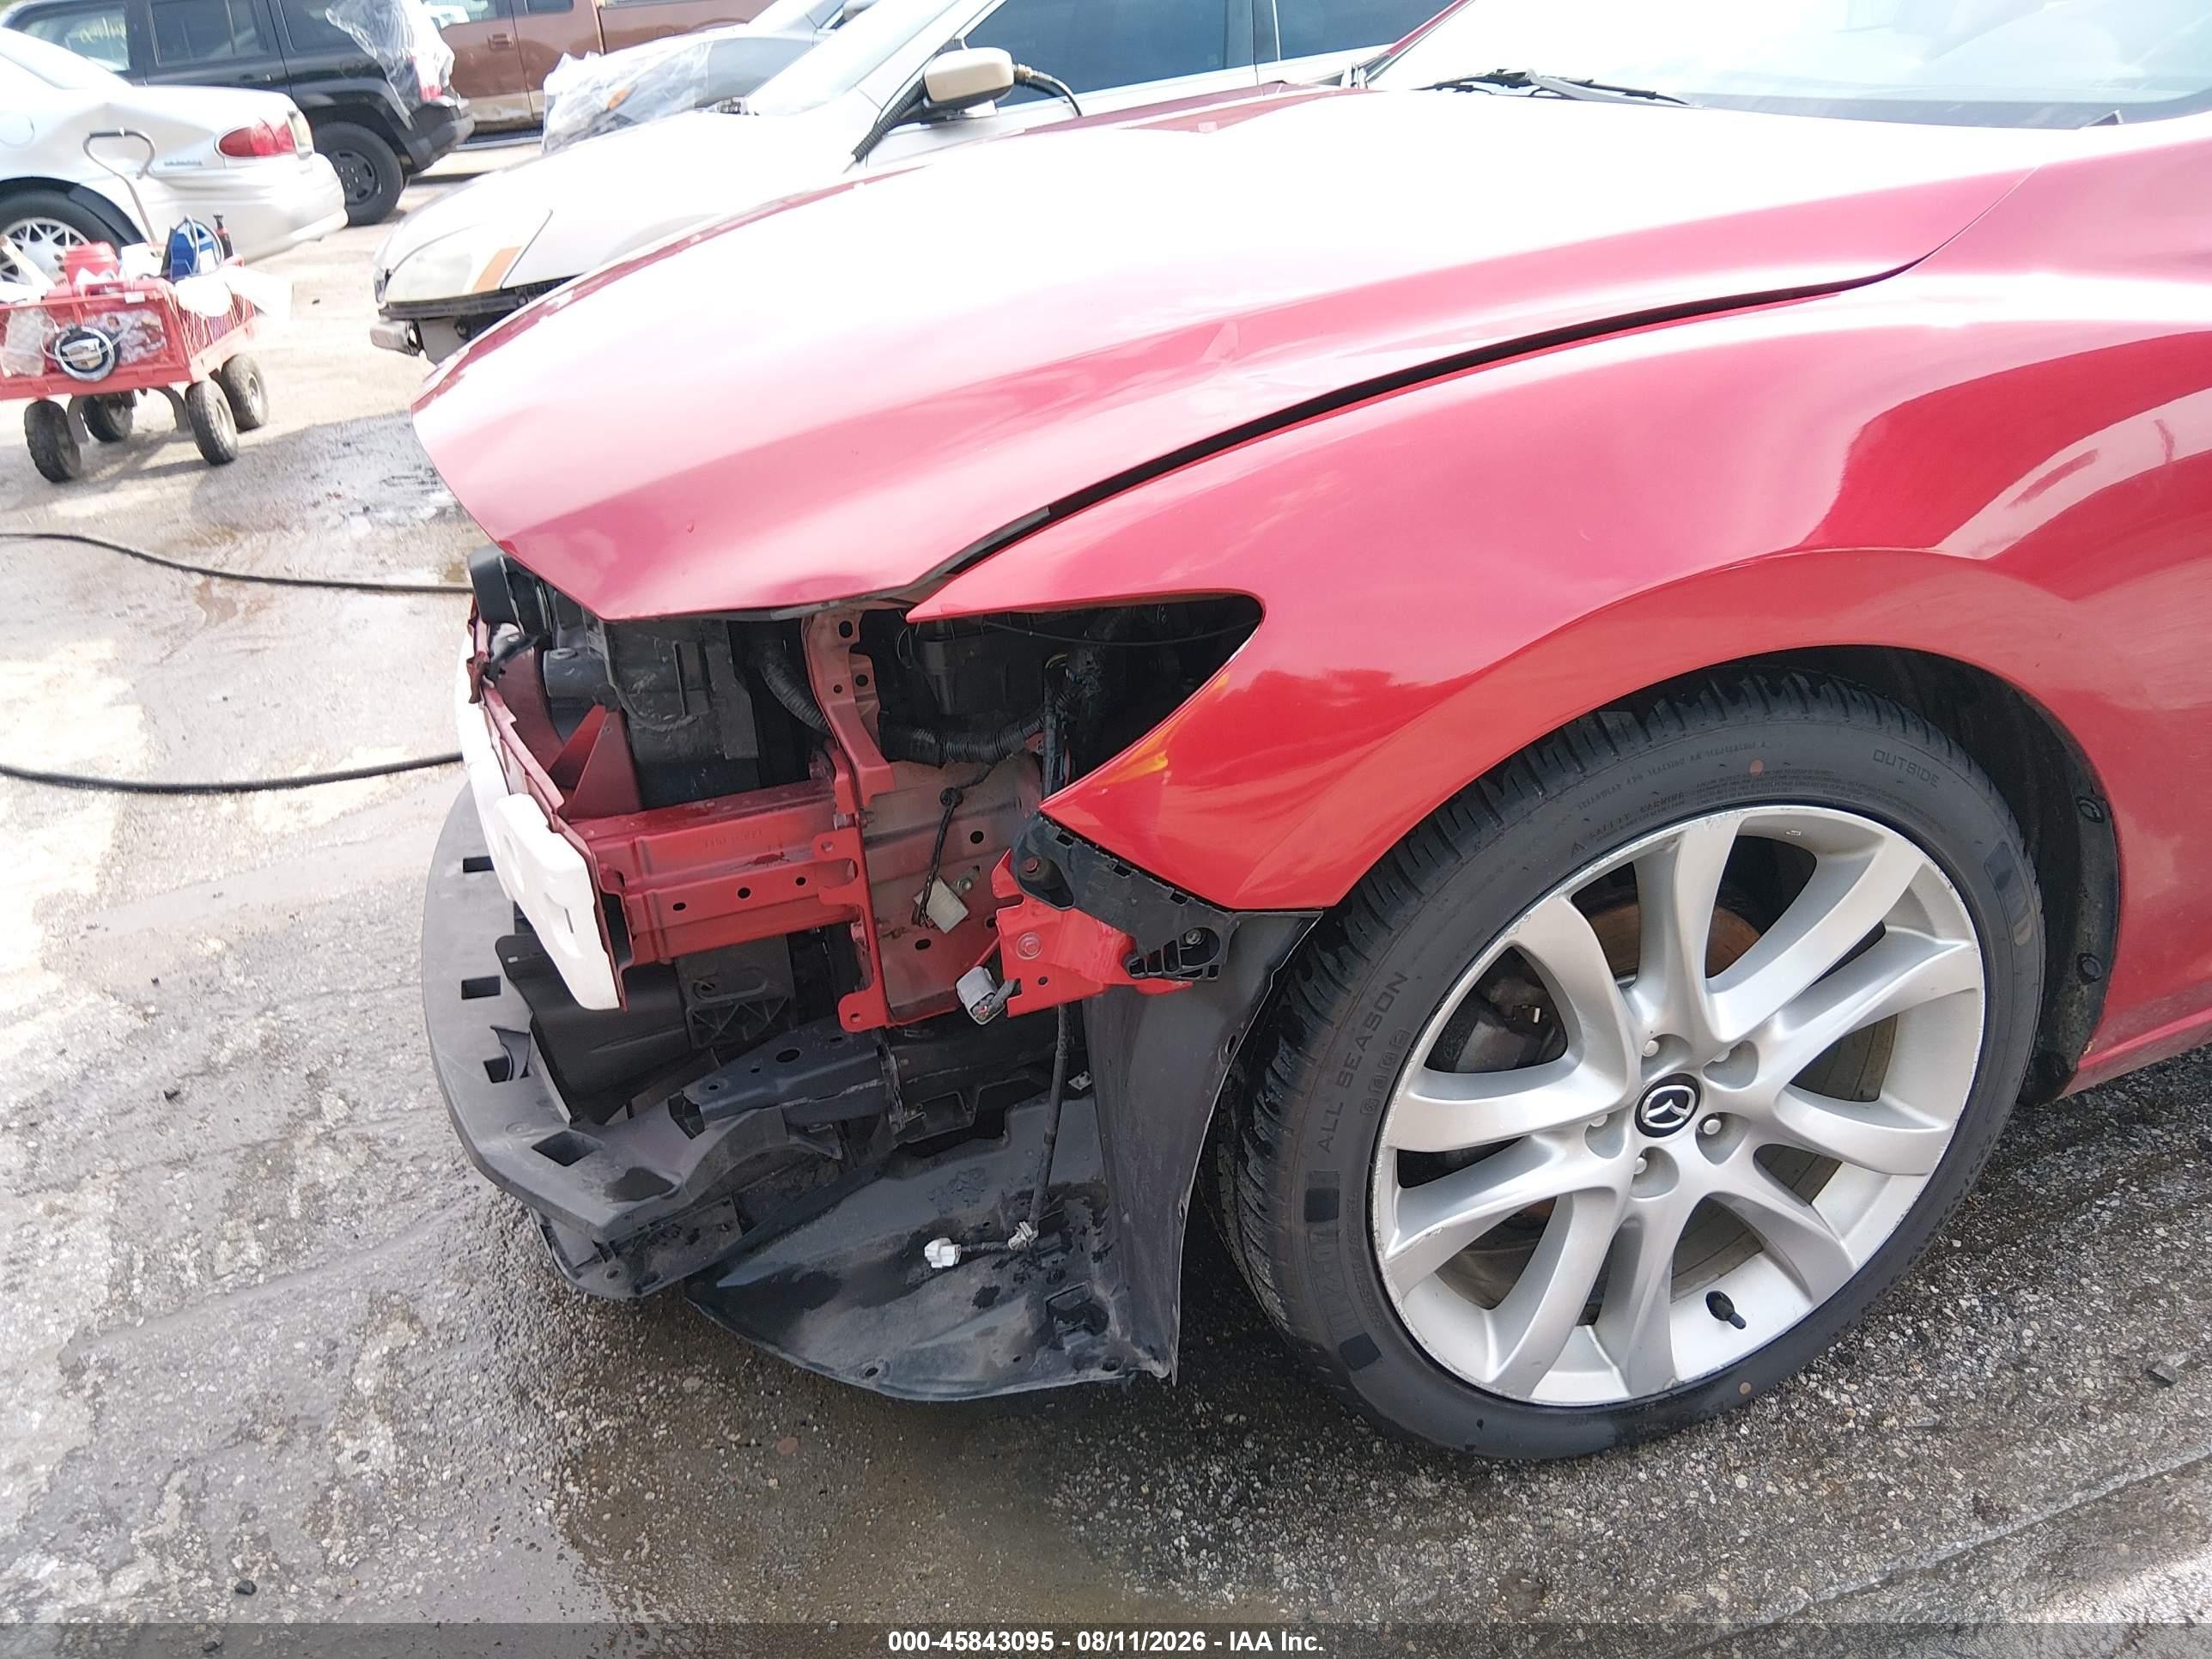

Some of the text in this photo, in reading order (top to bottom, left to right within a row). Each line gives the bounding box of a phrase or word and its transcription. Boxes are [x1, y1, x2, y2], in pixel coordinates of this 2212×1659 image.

[1872, 749, 1941, 789] OUTSIDE
[1317, 971, 1409, 1153] ALL SEASON
